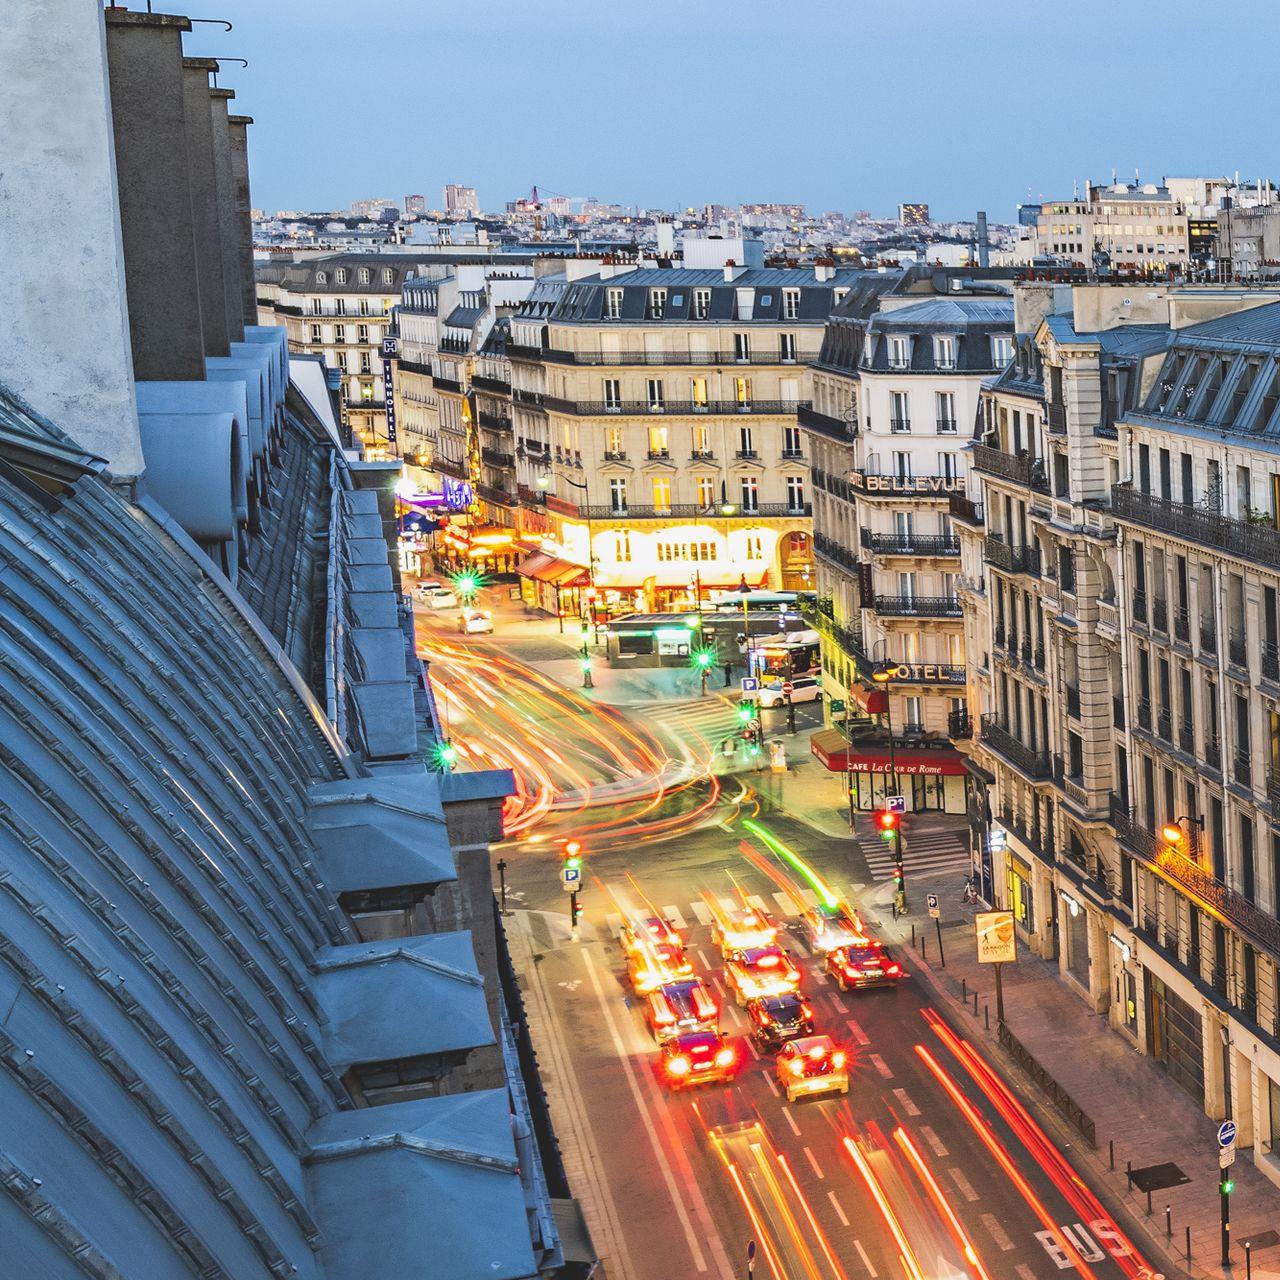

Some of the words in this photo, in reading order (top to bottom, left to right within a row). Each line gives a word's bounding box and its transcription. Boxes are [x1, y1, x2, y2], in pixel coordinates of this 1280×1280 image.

[385, 365, 396, 431] TIMHOTEL
[866, 475, 966, 491] BELLEVUE
[892, 664, 950, 680] OTEL
[745, 681, 754, 689] P
[872, 763, 883, 772] La
[919, 764, 942, 774] Rome
[887, 800, 897, 811] P
[567, 870, 577, 880] P
[1033, 1219, 1114, 1270] BUS
